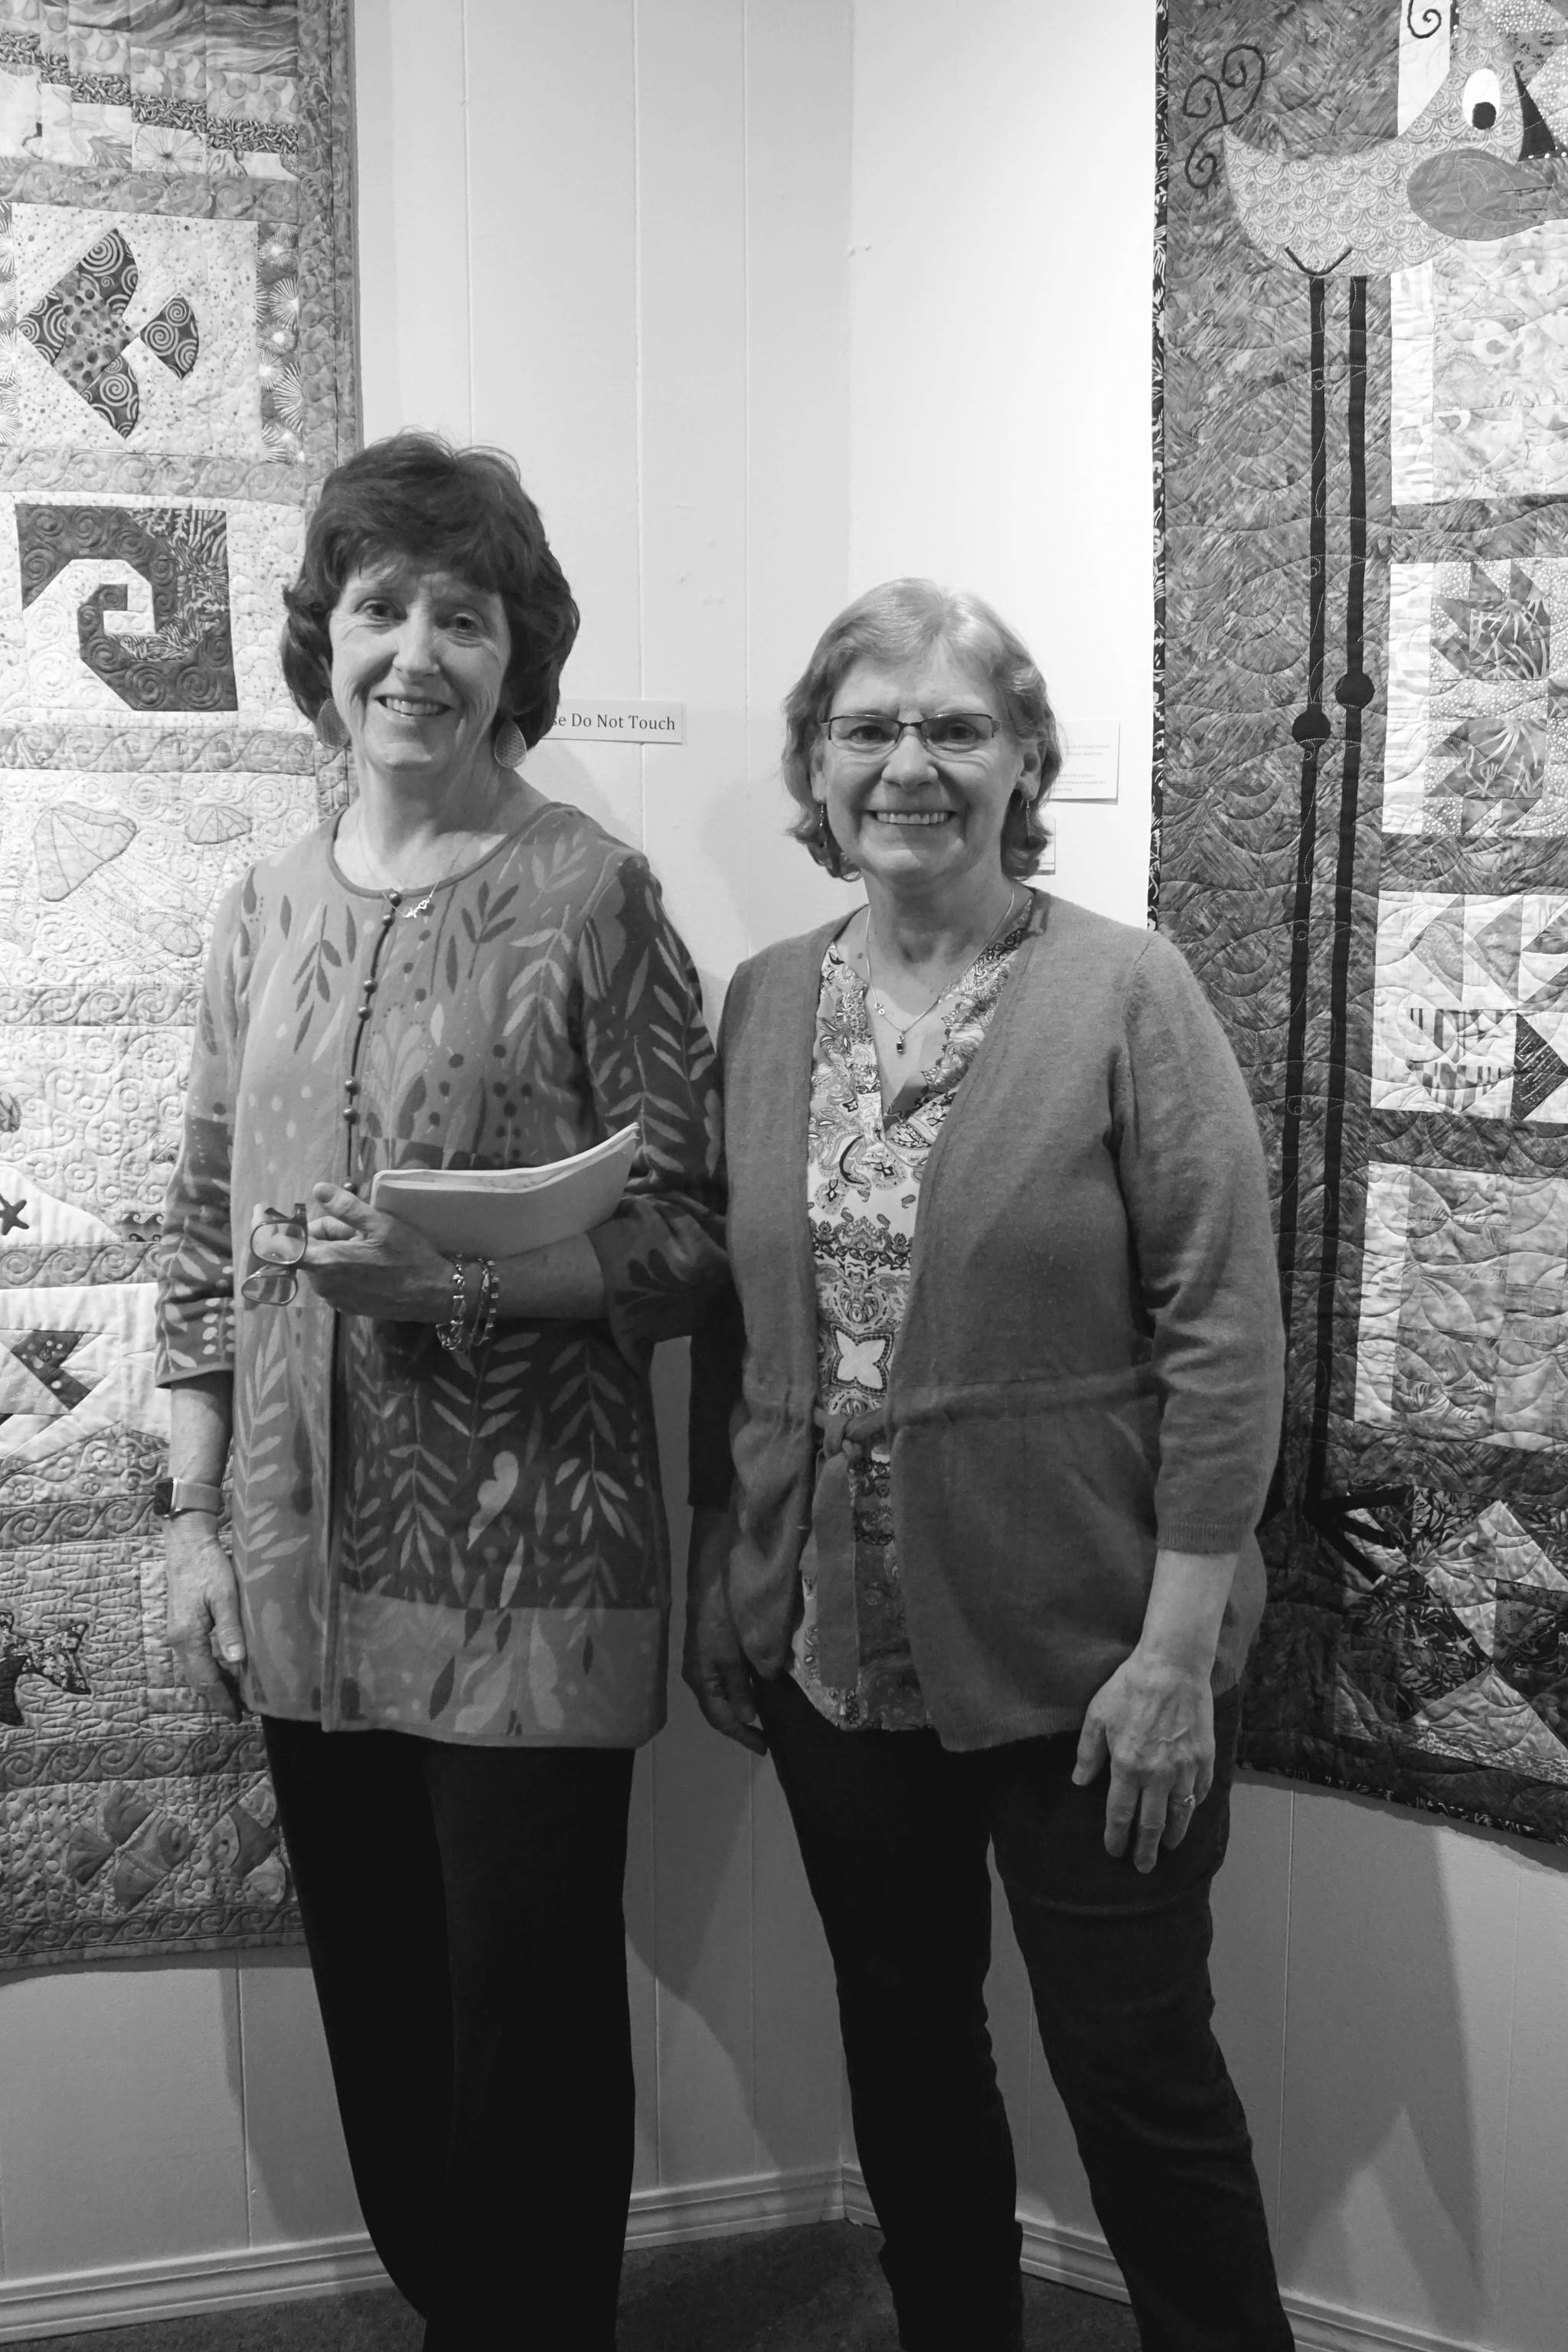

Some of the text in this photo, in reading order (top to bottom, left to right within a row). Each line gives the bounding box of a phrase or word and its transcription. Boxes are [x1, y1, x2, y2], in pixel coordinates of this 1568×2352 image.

[571, 713, 592, 727] Do
[597, 714, 624, 729] Not
[628, 715, 675, 730] Touch
